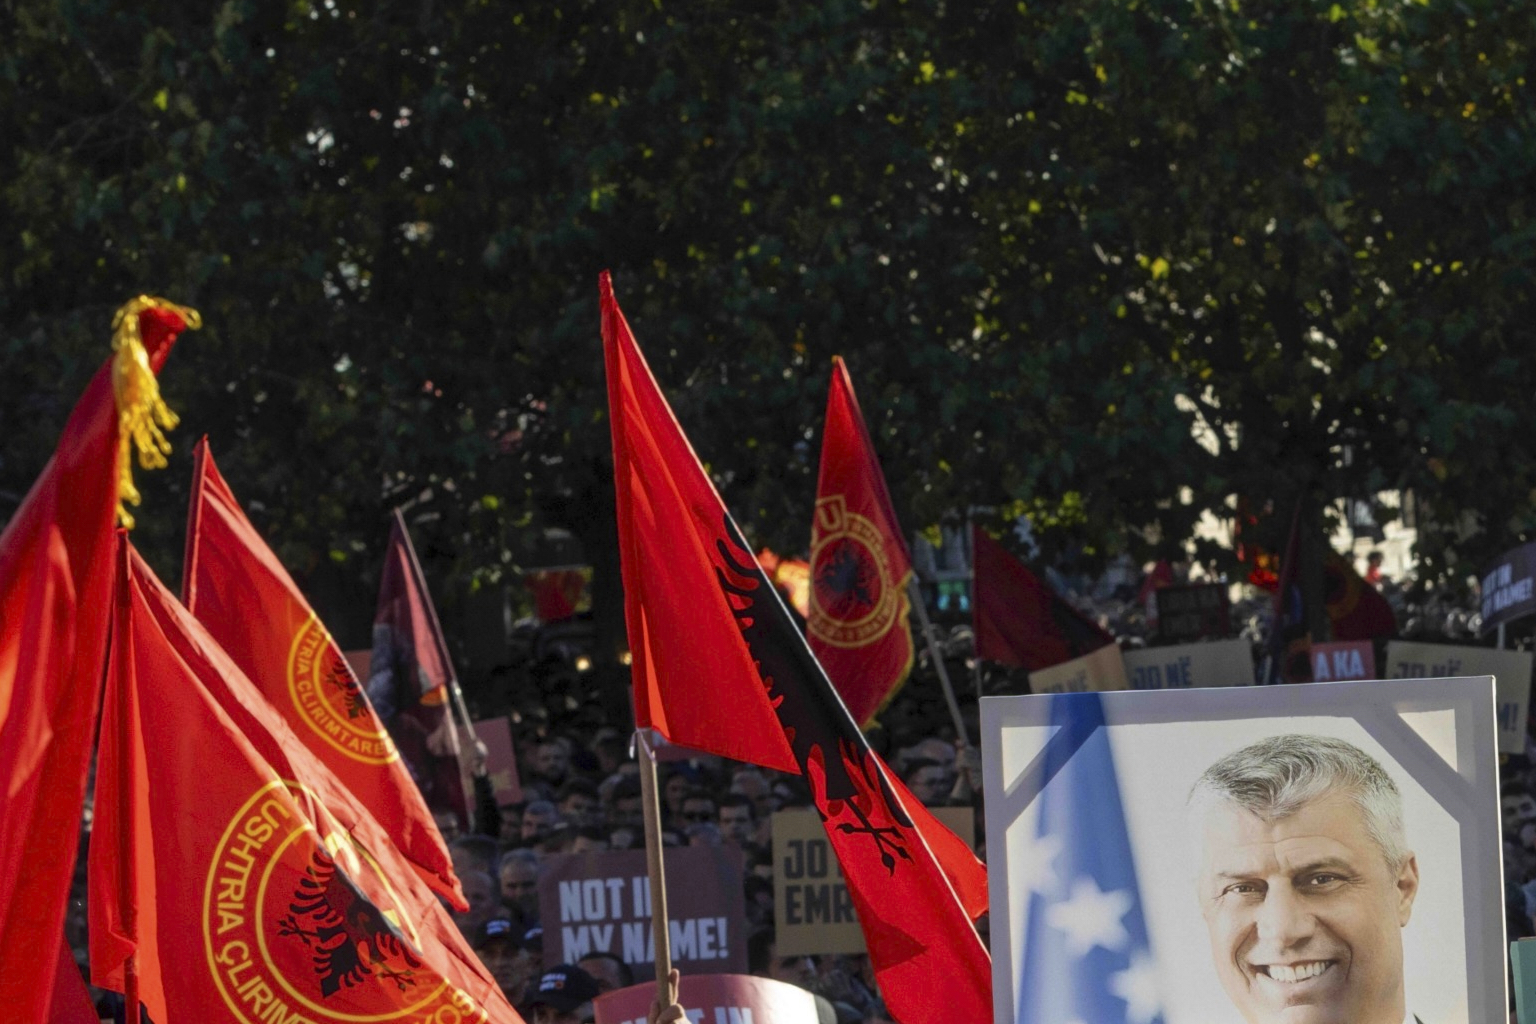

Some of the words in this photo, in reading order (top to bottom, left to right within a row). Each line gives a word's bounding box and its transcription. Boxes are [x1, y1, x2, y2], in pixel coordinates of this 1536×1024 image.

[1333, 649, 1365, 678] KA
[217, 797, 291, 936] USHTRIA
[783, 839, 828, 879] JO
[559, 876, 625, 922] NOT
[561, 923, 614, 966] MY
